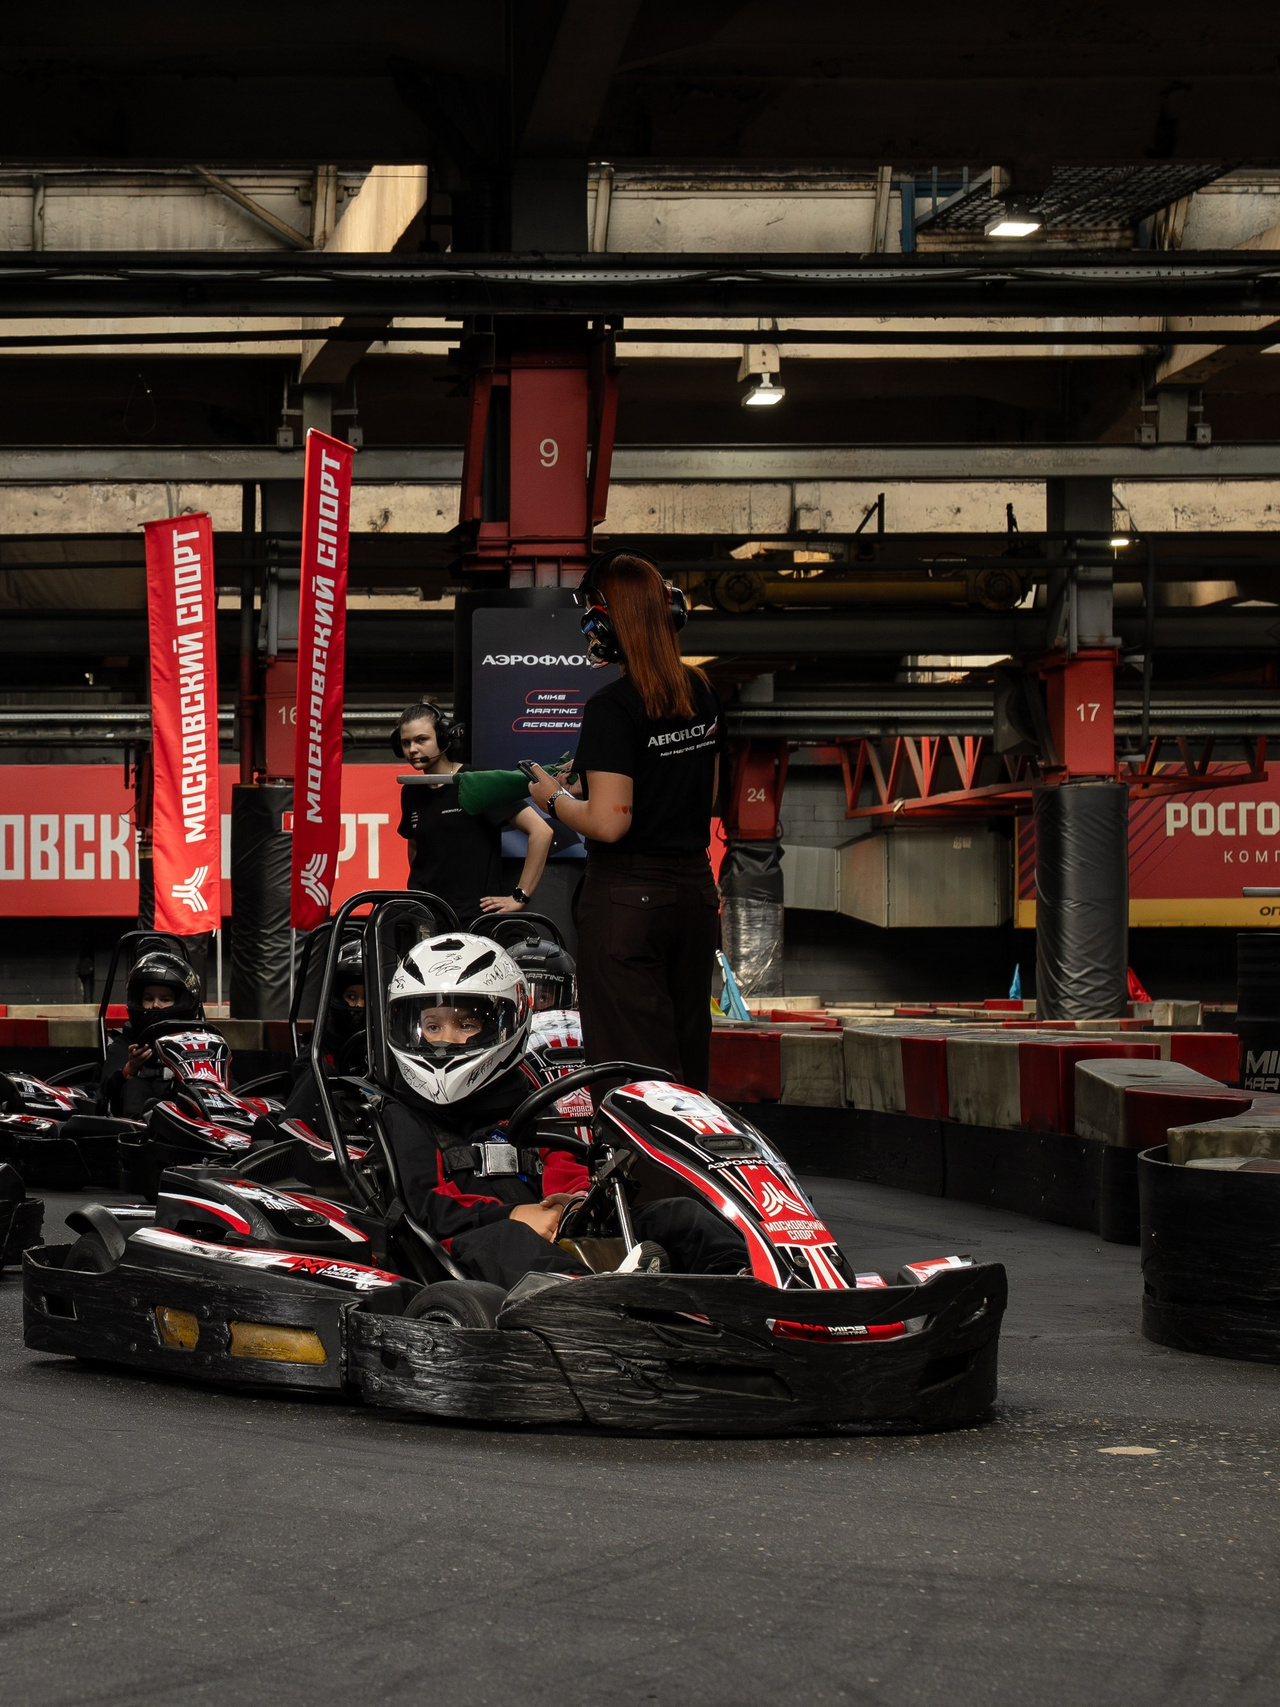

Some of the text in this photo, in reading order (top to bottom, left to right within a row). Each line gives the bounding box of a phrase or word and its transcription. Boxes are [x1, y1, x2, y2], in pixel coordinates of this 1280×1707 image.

[539, 438, 559, 467] 9
[306, 448, 341, 823] МОСКОВСКИЙ СПОРТ
[173, 529, 207, 843] МОСКОВСКИЙ СПОРТ
[278, 705, 297, 725] 16
[1076, 703, 1100, 722] 17
[747, 787, 766, 802] 24
[1166, 802, 1280, 836] РОСГО
[539, 1063, 587, 1073] АЭРОФЛО
[764, 1219, 826, 1232] МОСКОВСКИЙ
[787, 1230, 818, 1240] СПОРТ
